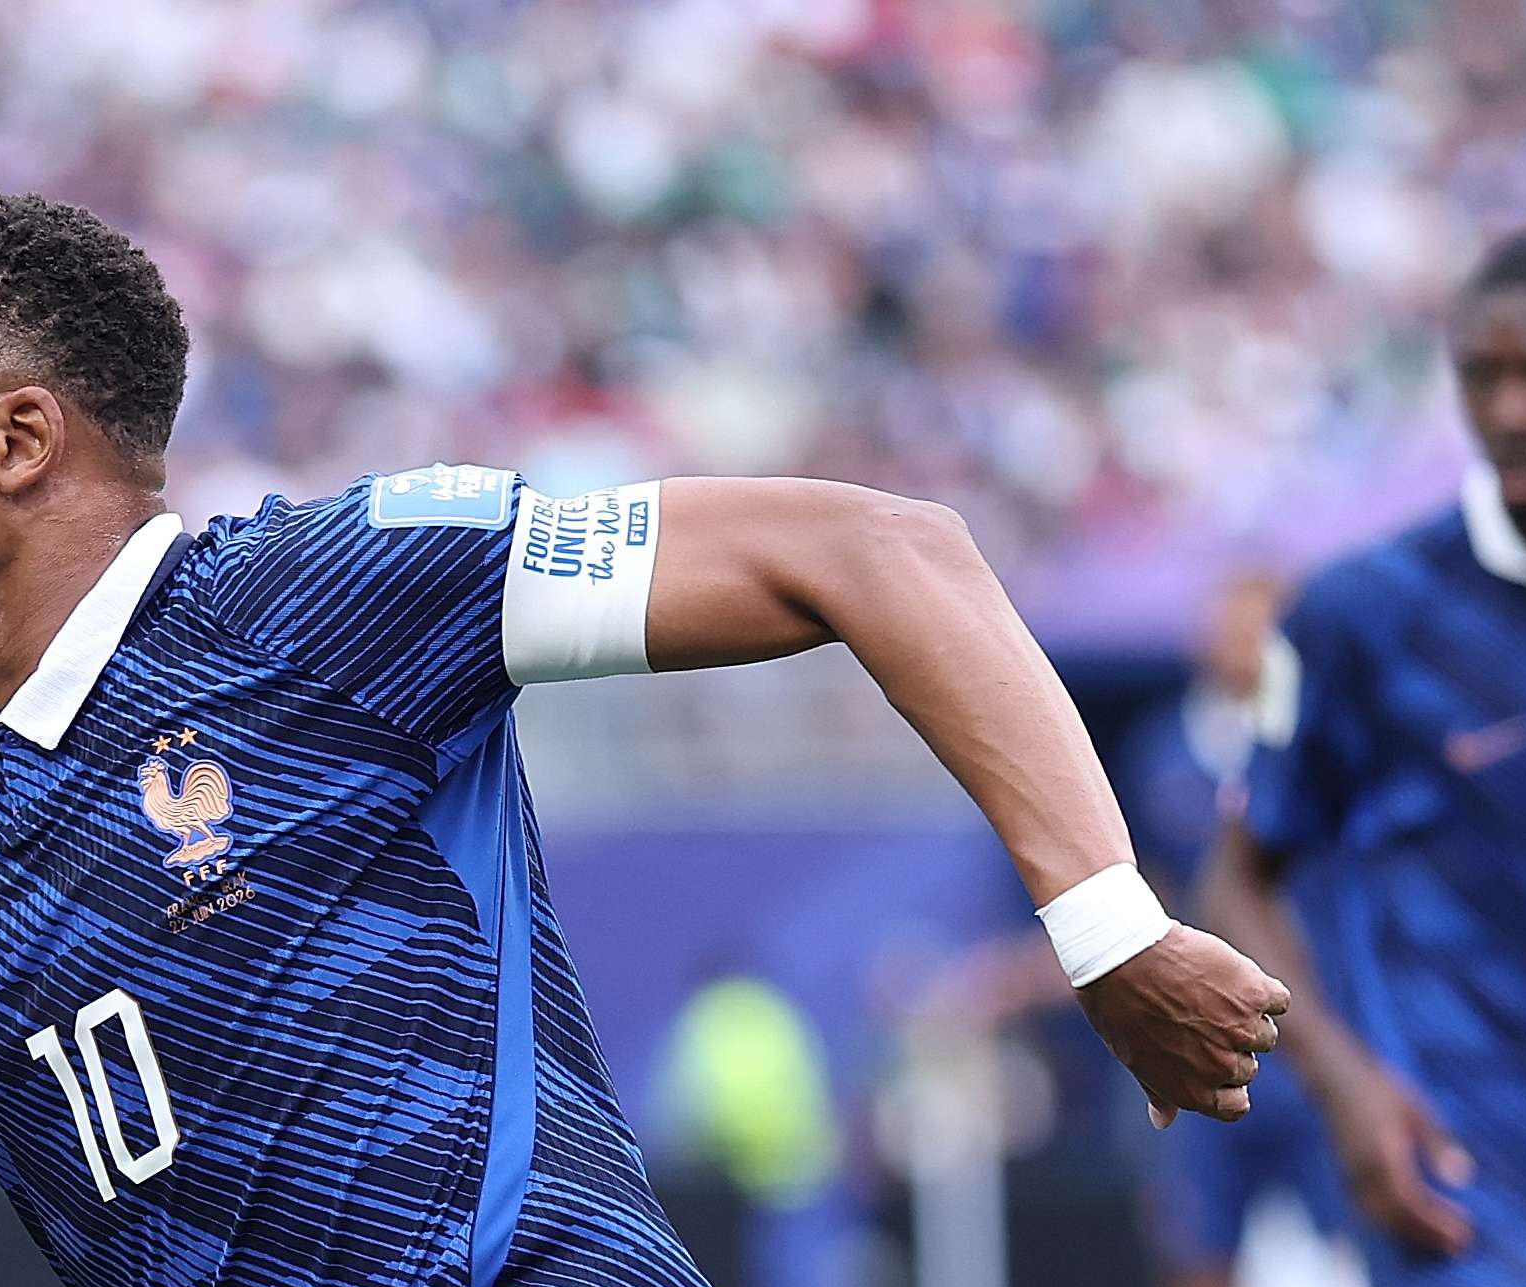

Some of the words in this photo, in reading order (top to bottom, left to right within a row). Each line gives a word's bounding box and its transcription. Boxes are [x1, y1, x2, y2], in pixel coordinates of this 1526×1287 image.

[549, 497, 589, 577] UNITE
[628, 503, 647, 543] FIFA
[587, 541, 616, 586] the
[170, 920, 189, 934] 22
[217, 885, 255, 912] 2026
[25, 988, 180, 1203] 10
